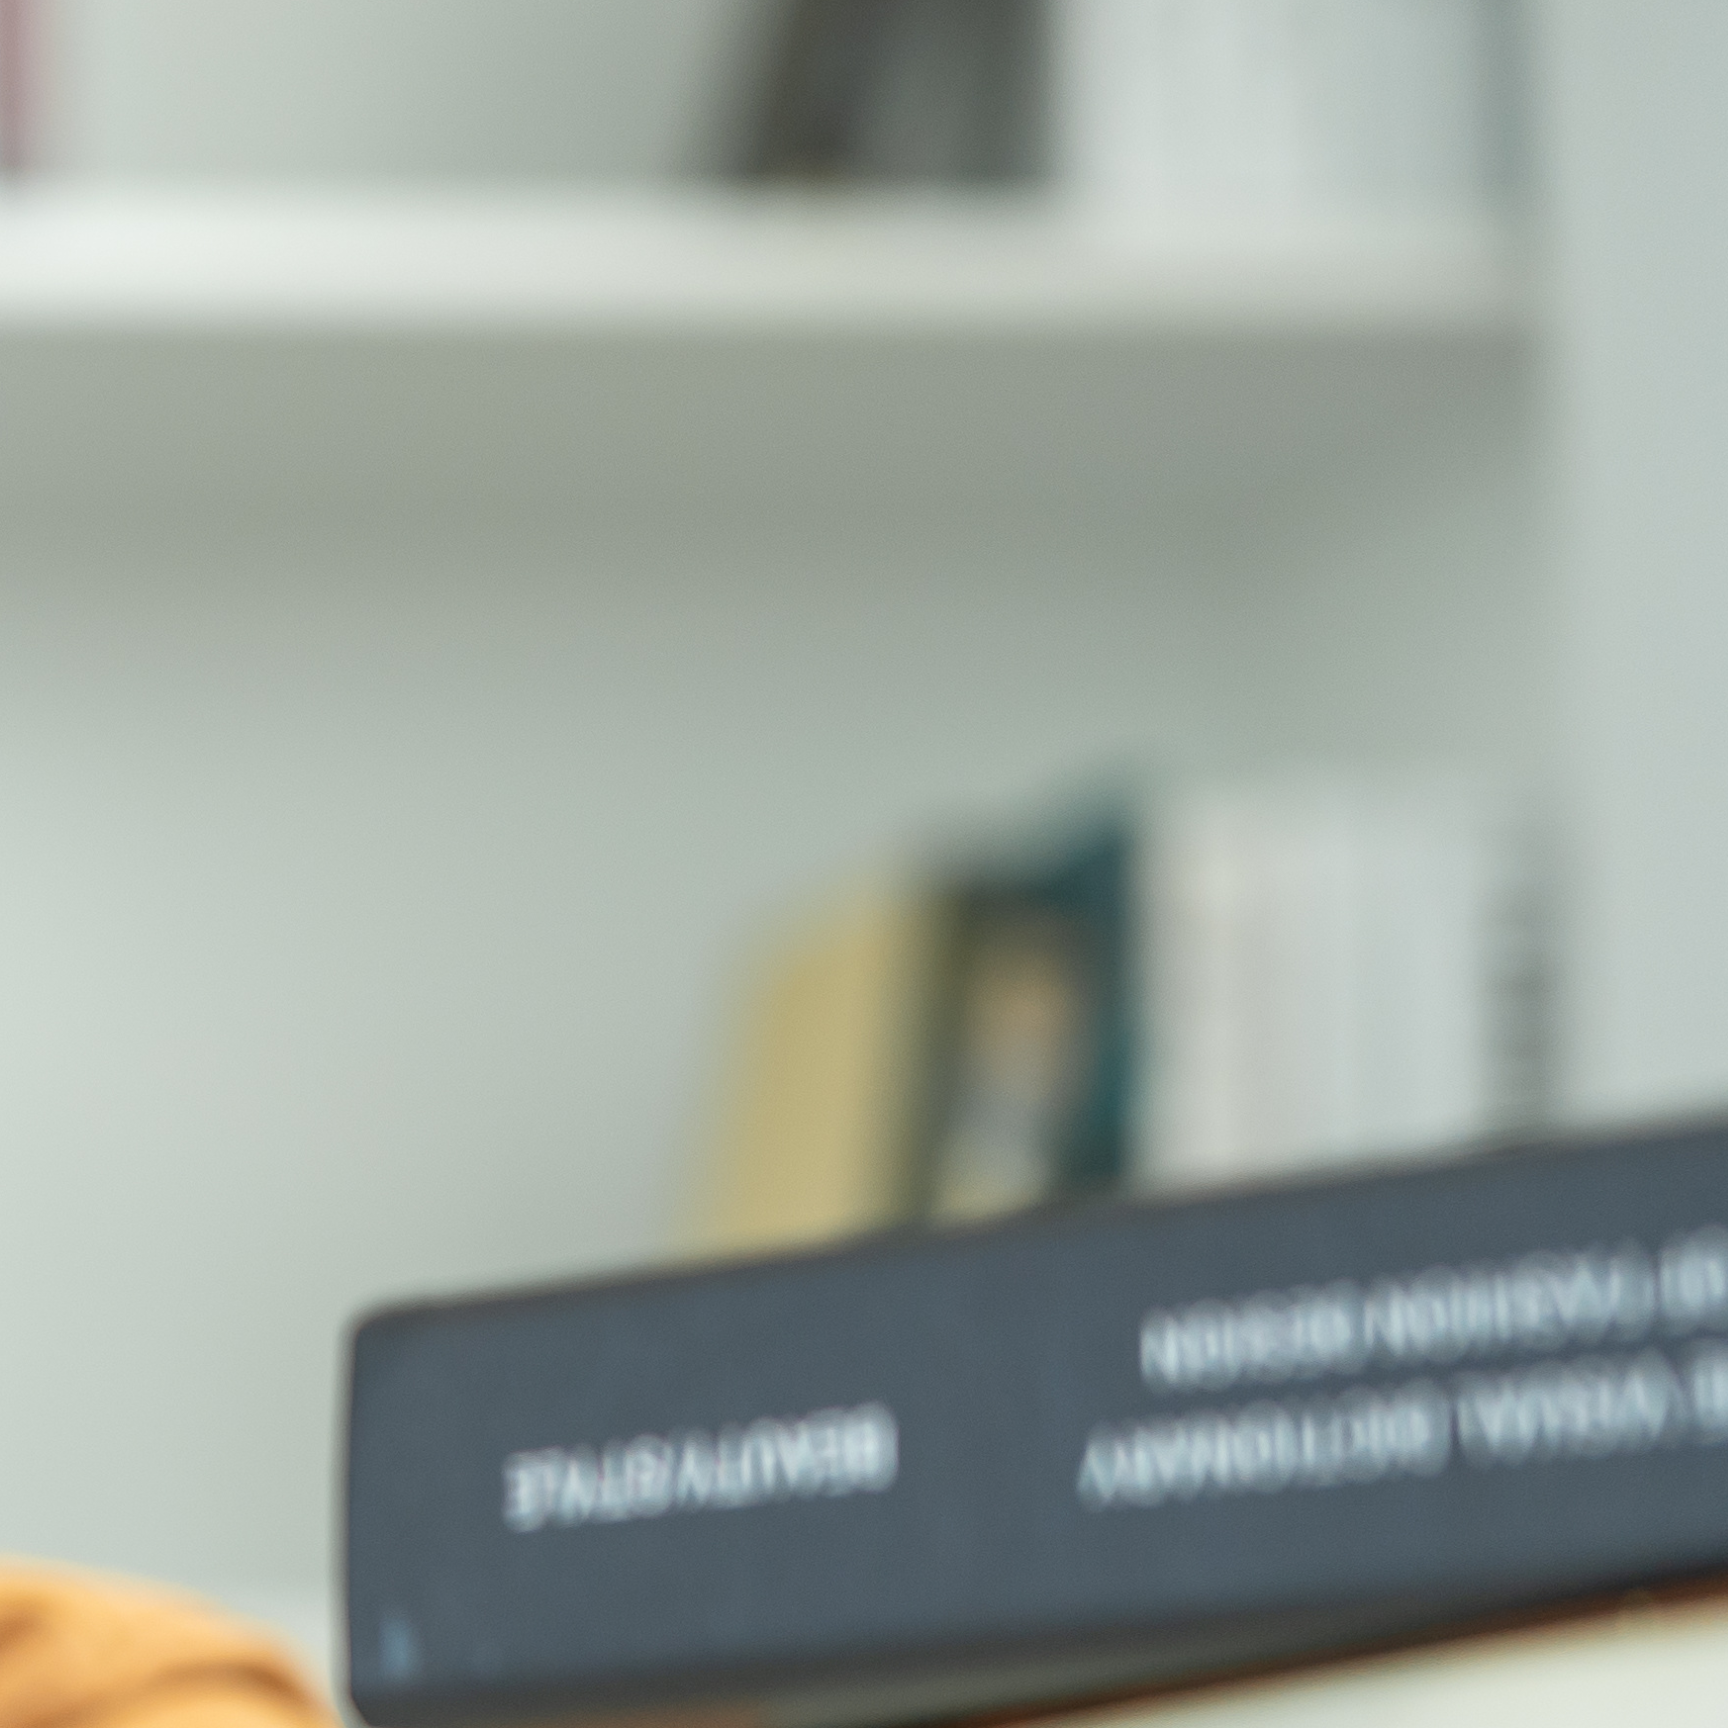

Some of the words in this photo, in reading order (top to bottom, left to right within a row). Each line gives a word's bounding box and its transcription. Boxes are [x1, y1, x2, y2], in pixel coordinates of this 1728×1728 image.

[1141, 1281, 1366, 1391] DESIGN
[1366, 1238, 1654, 1362] FASHION
[1077, 1379, 1450, 1509] DICTIONARY
